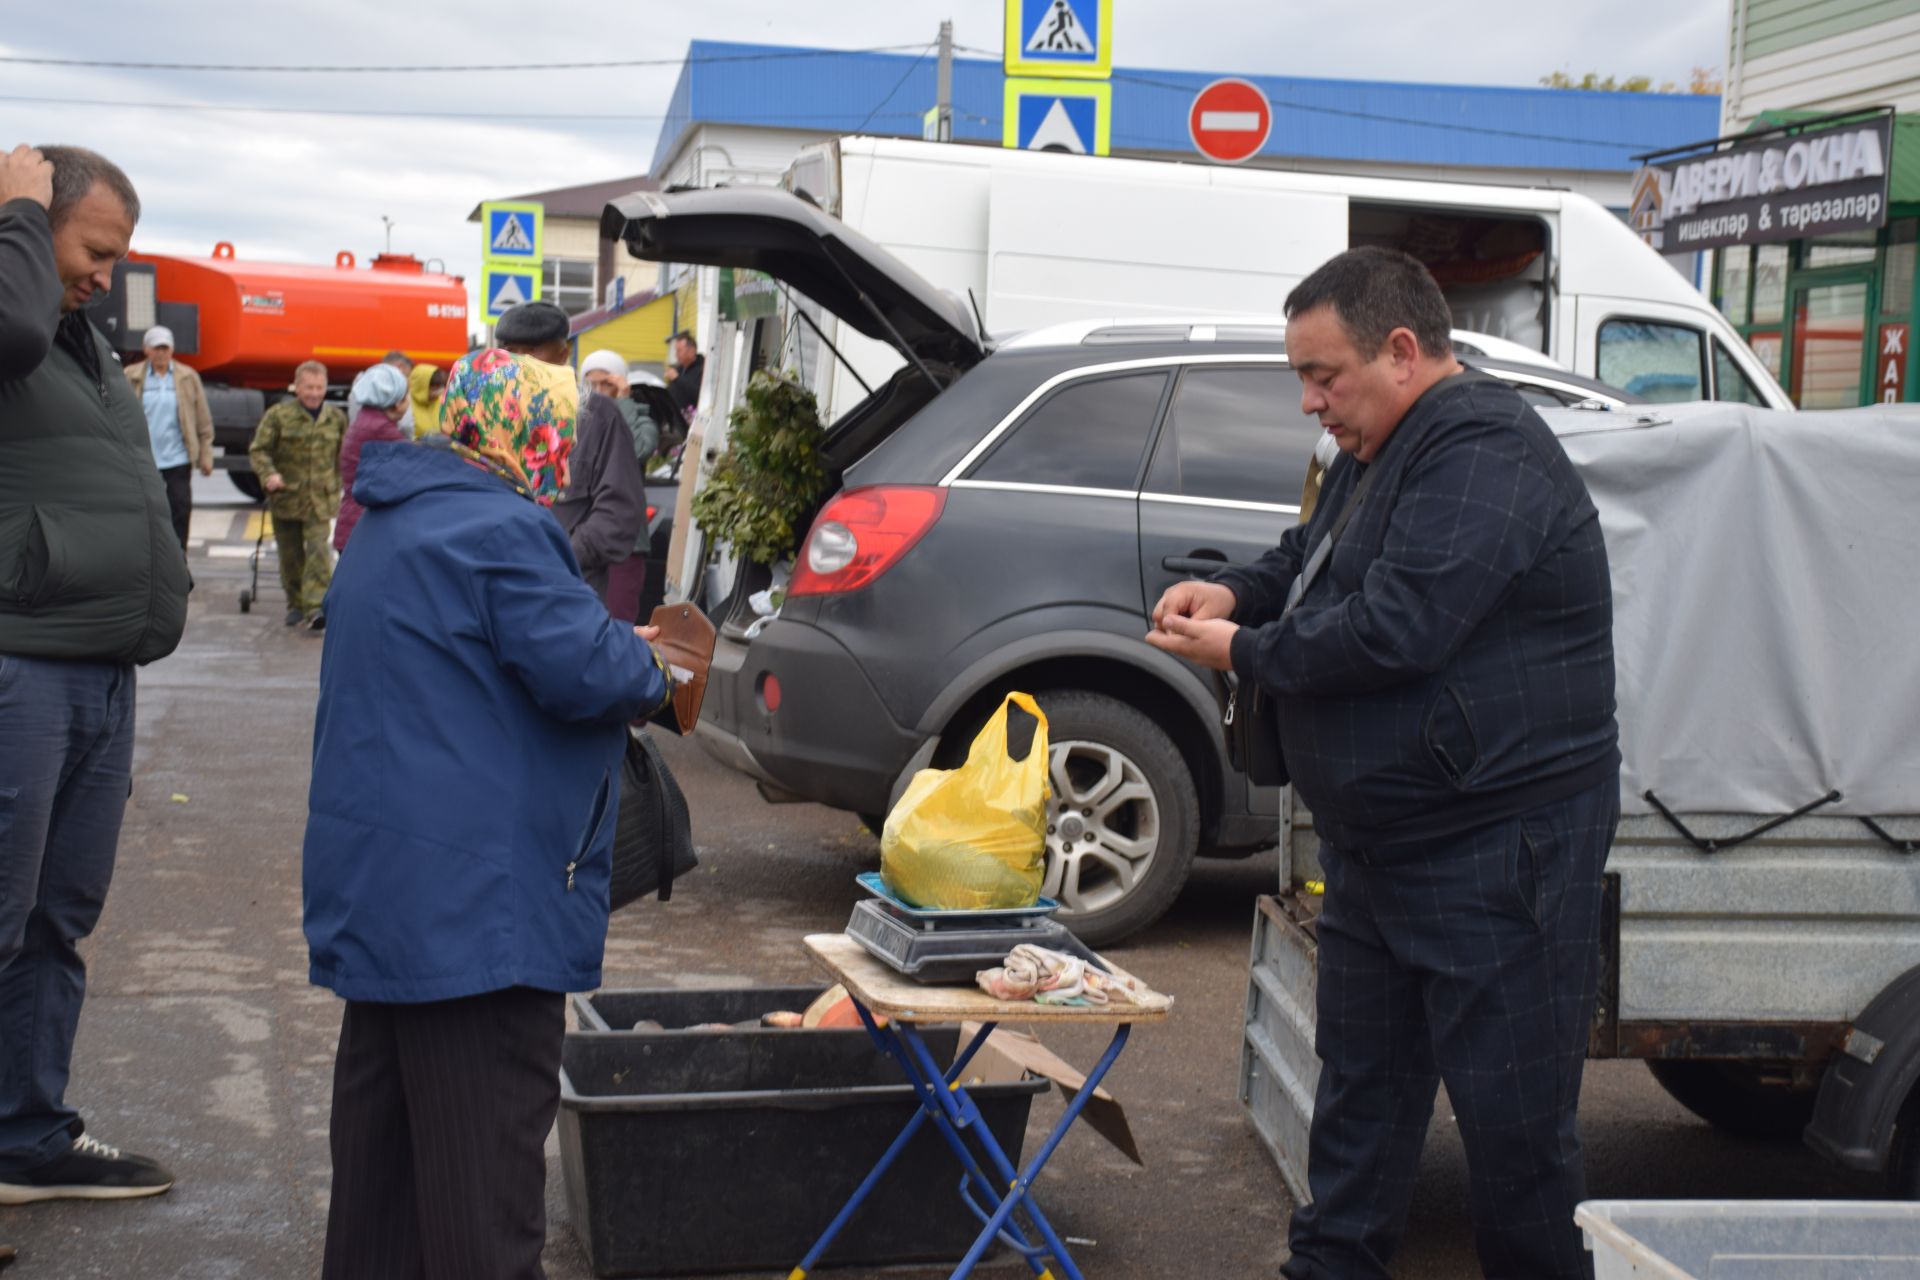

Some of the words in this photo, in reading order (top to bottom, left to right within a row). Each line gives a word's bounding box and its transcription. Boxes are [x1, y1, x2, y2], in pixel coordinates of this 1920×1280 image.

[1667, 152, 1759, 219] ДВЕРИ
[1758, 148, 1783, 194] &
[1784, 129, 1883, 189] ОКНА
[1679, 213, 1748, 242] ишекләр
[1759, 203, 1772, 231] &
[1780, 193, 1881, 230] тәрәзәләр
